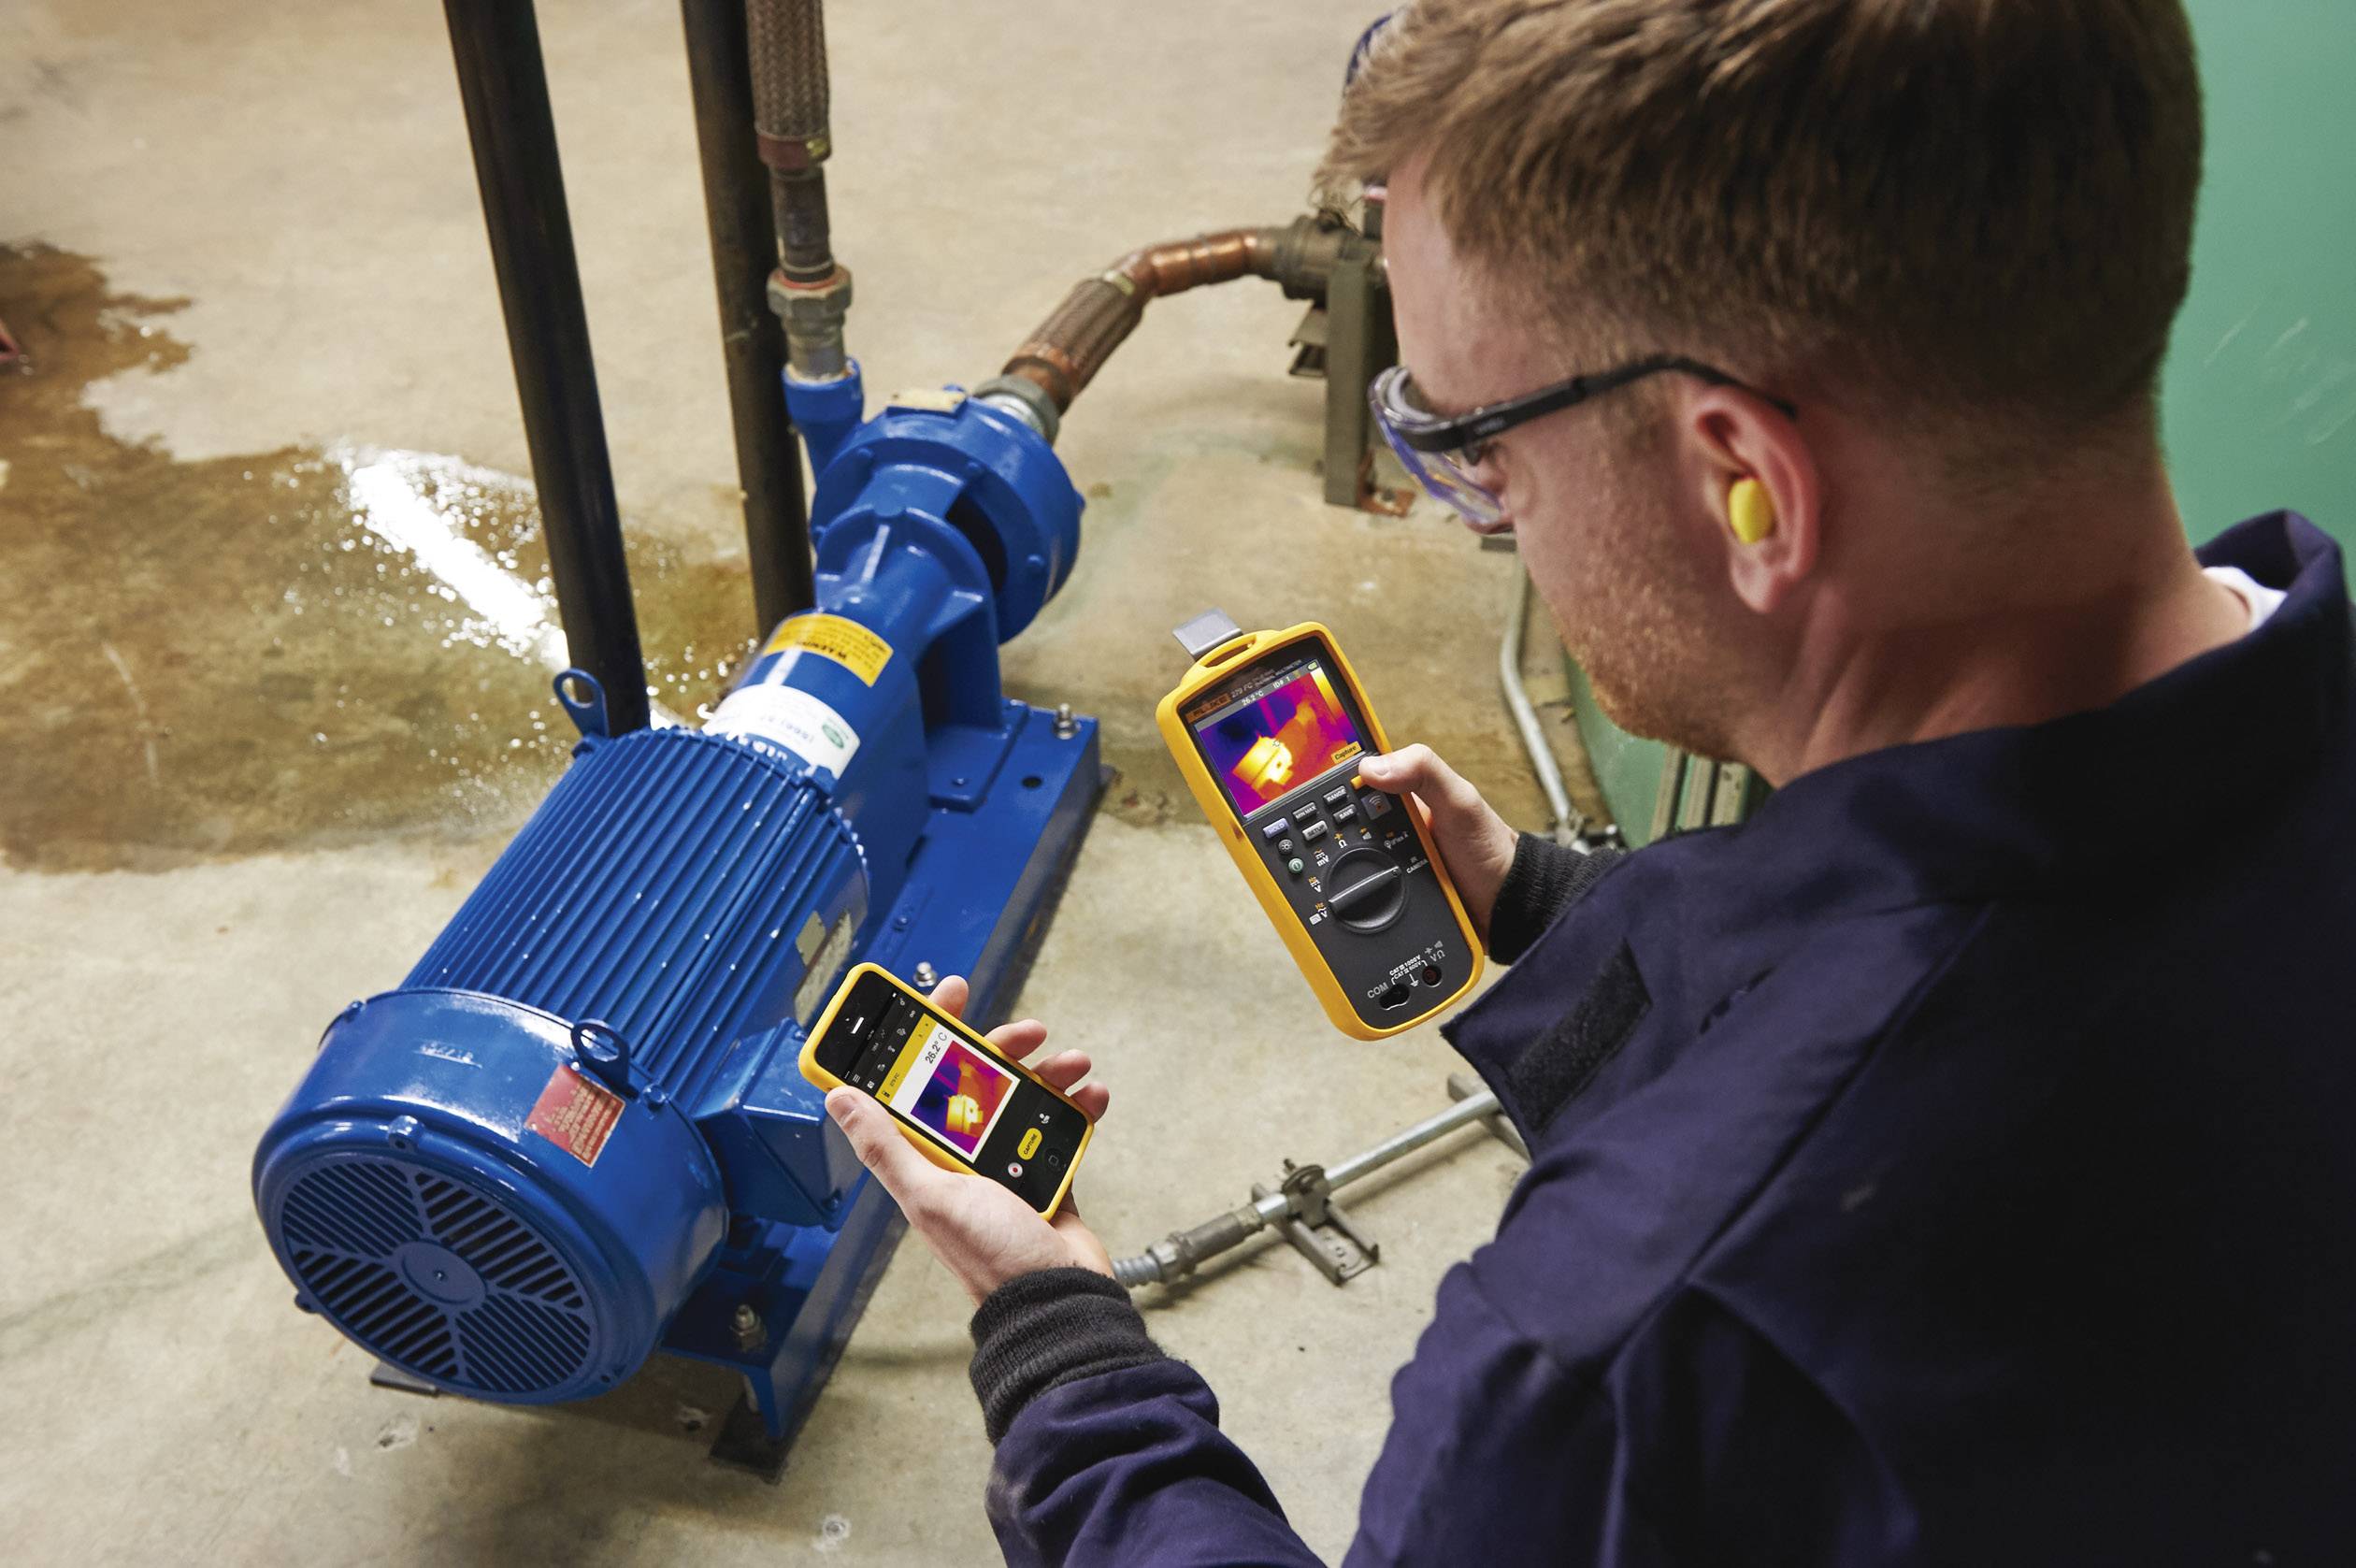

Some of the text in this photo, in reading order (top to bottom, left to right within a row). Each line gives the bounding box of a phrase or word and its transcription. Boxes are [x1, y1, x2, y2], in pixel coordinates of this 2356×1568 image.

[1241, 694, 1256, 706] 26.2
[1334, 744, 1357, 760] Capture
[1327, 788, 1347, 802] RANGE
[1339, 808, 1355, 820] SAVE
[1268, 822, 1286, 833] HOLD
[1307, 825, 1325, 837] SETUP
[1367, 982, 1389, 999] COM
[1023, 1133, 1038, 1155] CAPTURE
